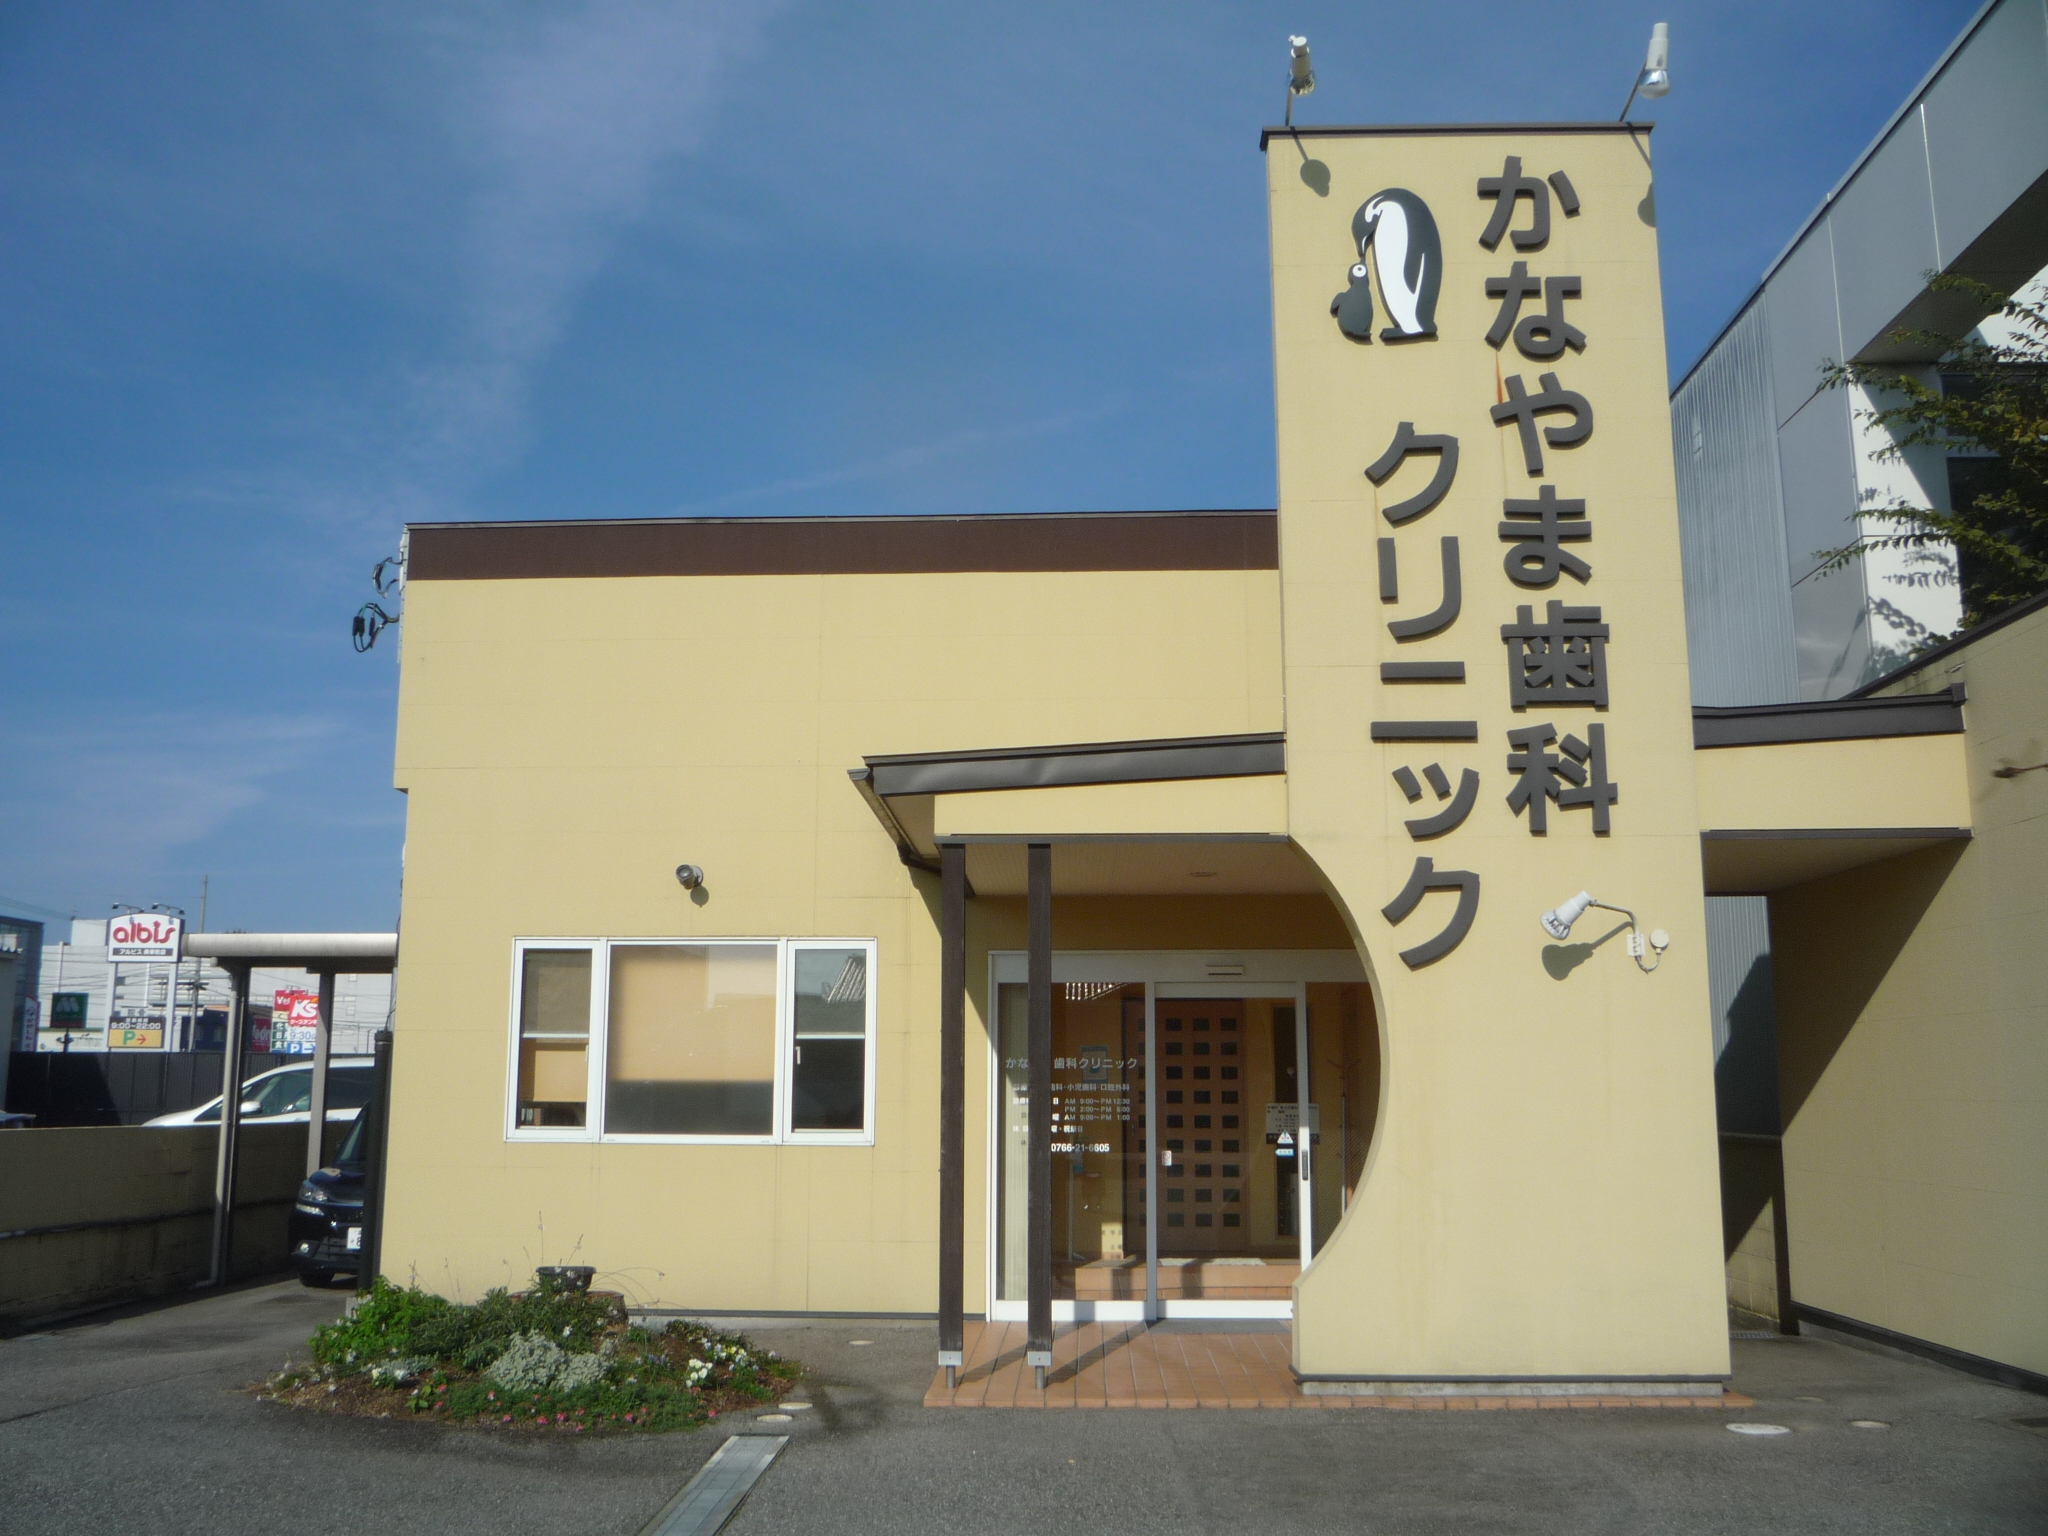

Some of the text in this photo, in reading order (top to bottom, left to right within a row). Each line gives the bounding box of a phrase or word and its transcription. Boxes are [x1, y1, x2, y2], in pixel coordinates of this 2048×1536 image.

[1476, 155, 1618, 837] かなやま歯科
[1364, 421, 1481, 969] クリニック
[112, 920, 176, 943] albis
[122, 1030, 136, 1045] P
[290, 1043, 300, 1053] P
[1051, 1143, 1110, 1152] 0766-21-6605
